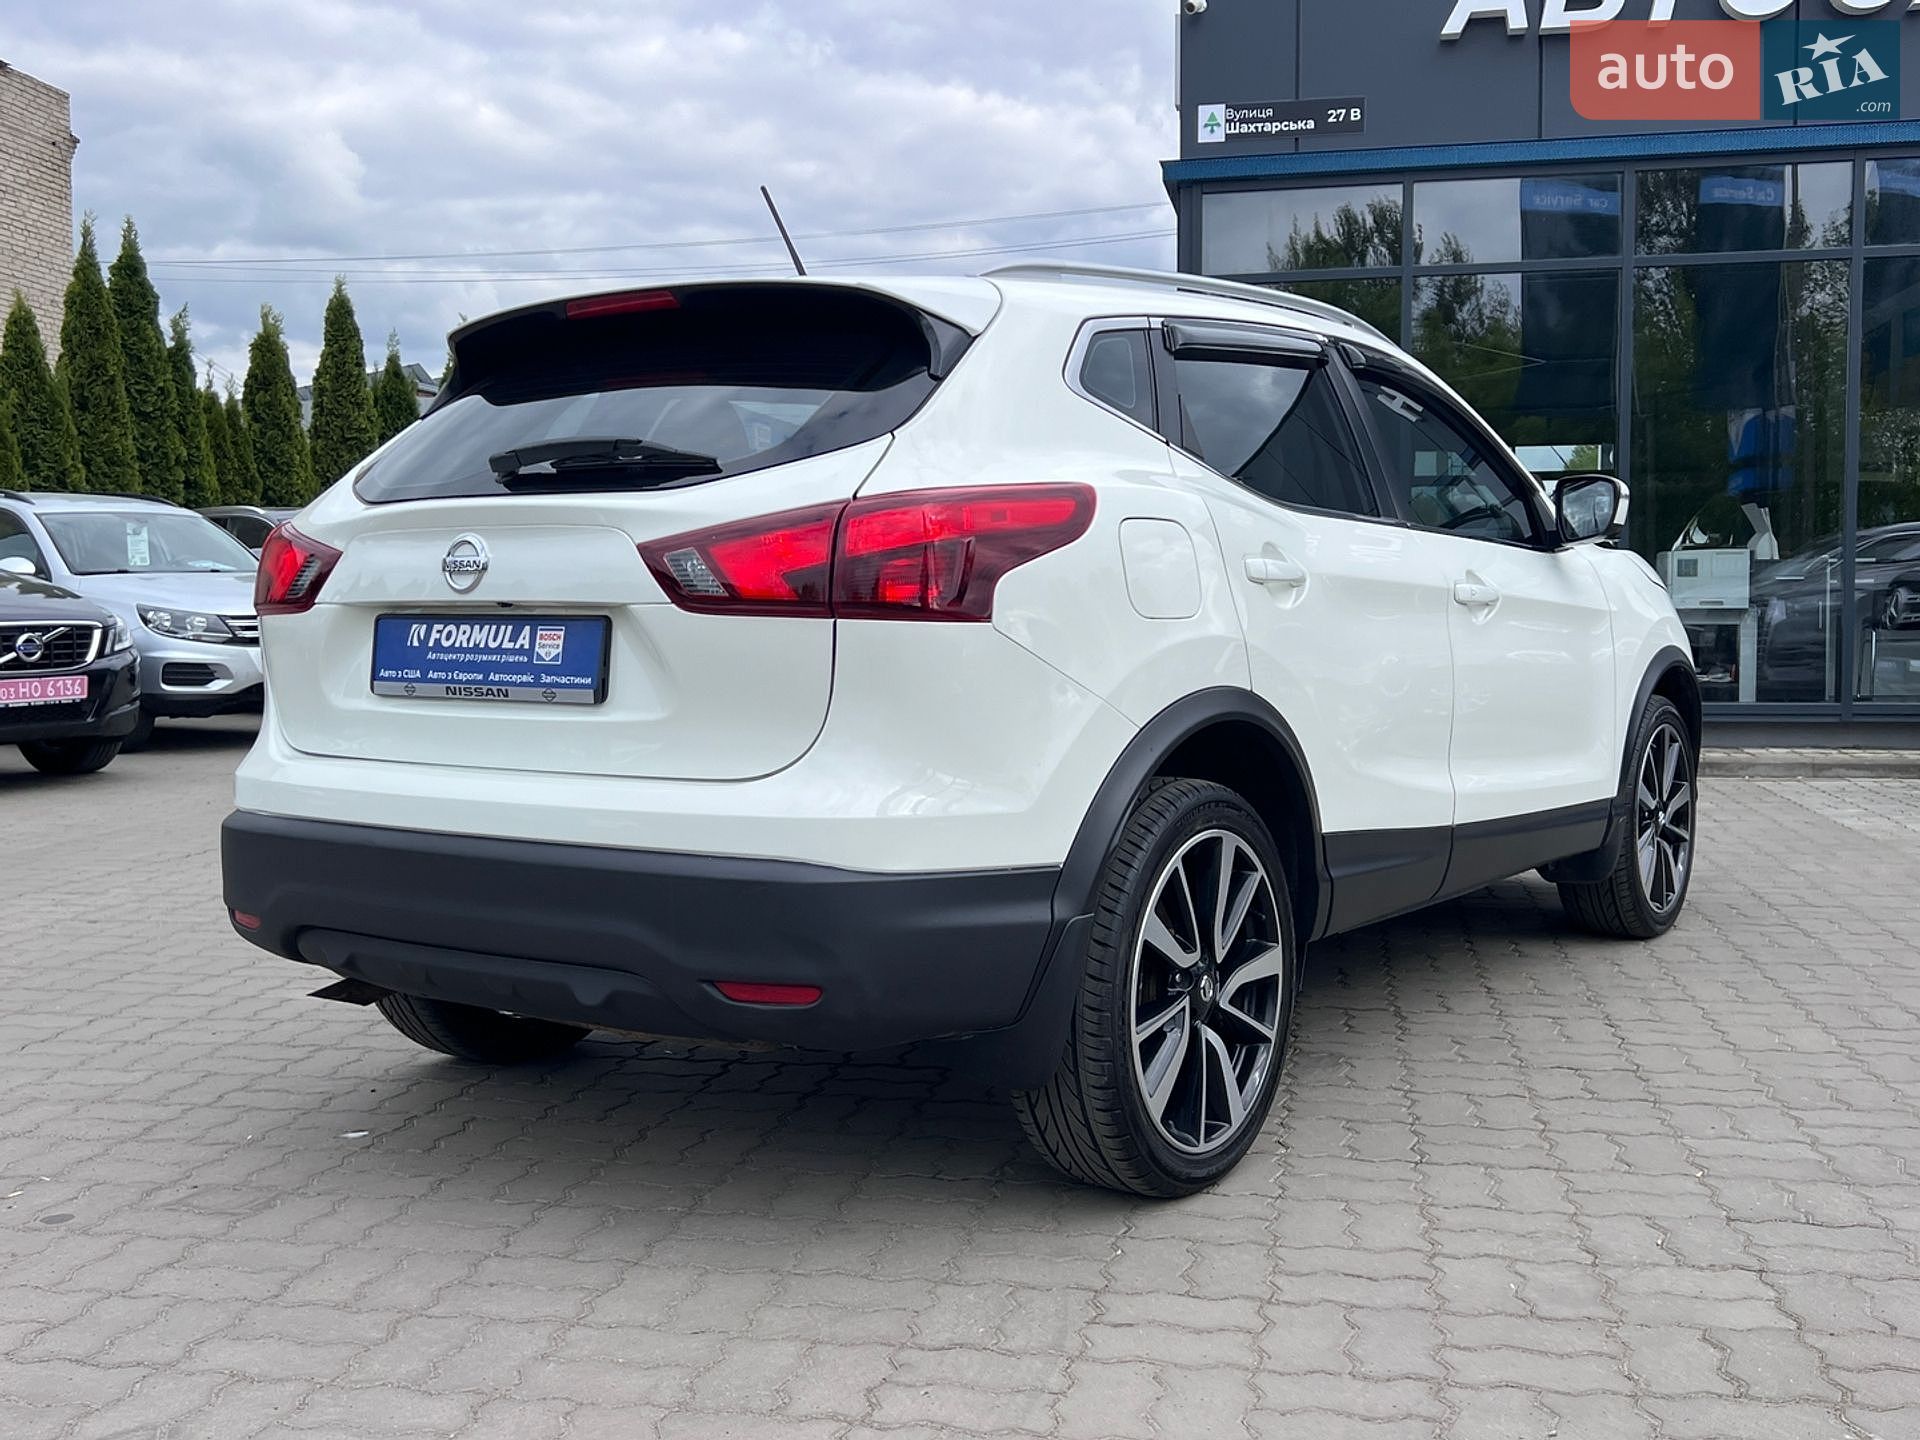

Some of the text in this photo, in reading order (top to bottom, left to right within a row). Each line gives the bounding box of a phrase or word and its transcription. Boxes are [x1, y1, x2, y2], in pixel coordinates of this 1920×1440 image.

[1226, 107, 1274, 121] Вулиця
[1226, 118, 1315, 134] Шахтарська
[1327, 109, 1346, 123] 27
[446, 559, 481, 569] NISSAN
[428, 623, 531, 649] FORMULA
[539, 633, 561, 641] BOSCH
[538, 642, 560, 650] Service
[379, 668, 396, 678] Авто
[402, 669, 421, 678] США
[427, 670, 446, 679] Авто
[453, 670, 484, 682] Європи
[488, 671, 535, 683] Автосервіс
[540, 673, 592, 685] Запчастини
[0, 687, 16, 699] 03
[47, 679, 82, 697] 6136
[445, 686, 509, 698] NISSAN
